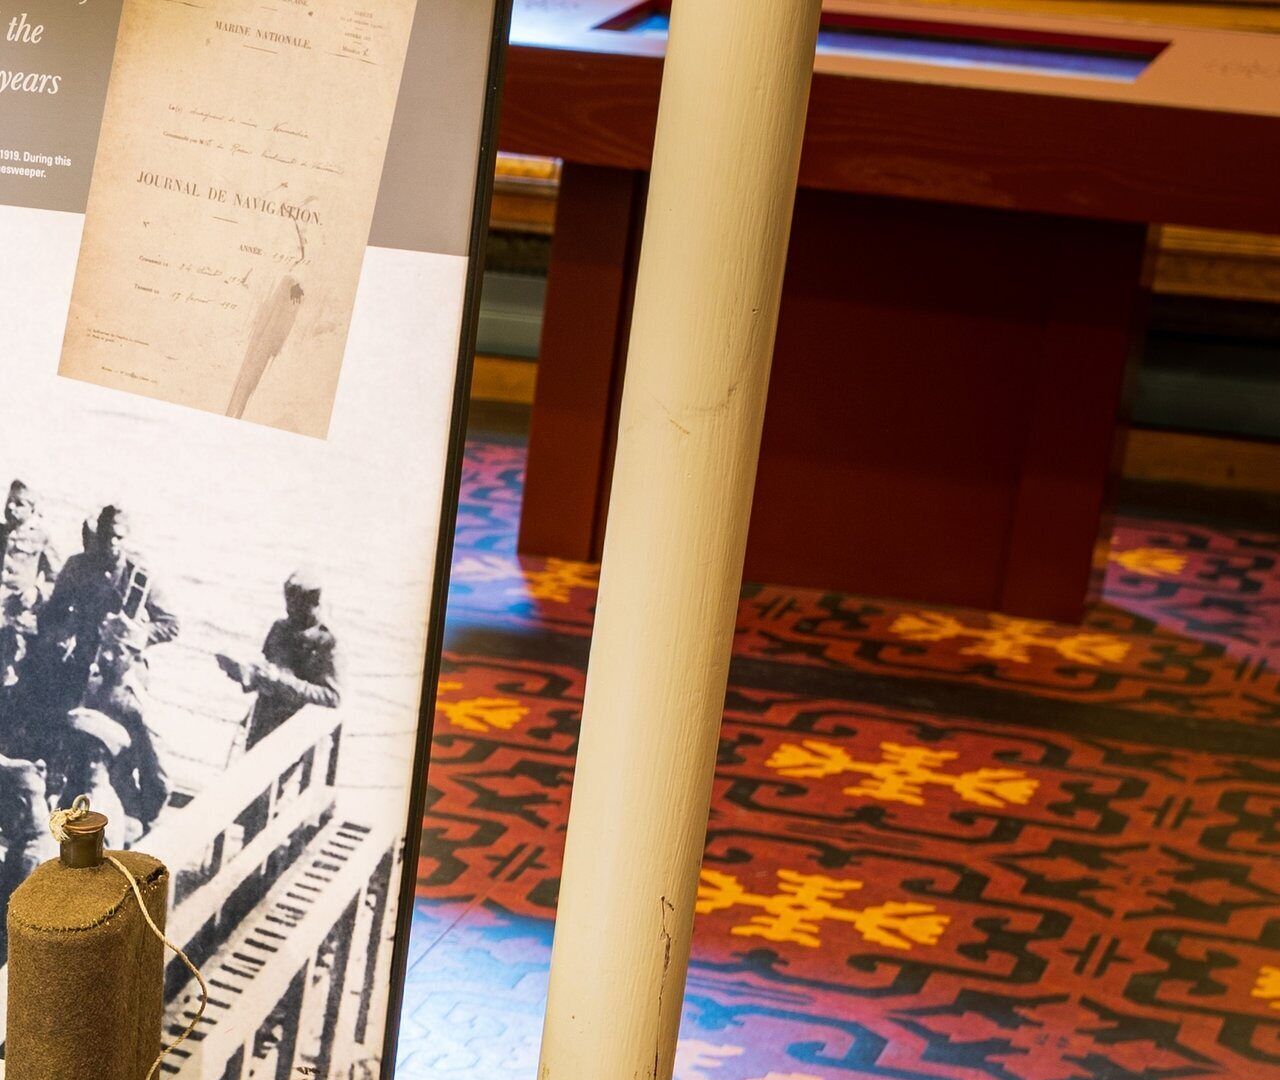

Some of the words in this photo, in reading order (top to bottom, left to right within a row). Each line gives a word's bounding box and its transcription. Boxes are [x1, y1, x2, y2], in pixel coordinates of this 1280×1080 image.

[6, 13, 44, 44] the
[214, 20, 251, 37] MARINE
[256, 29, 312, 50] NATIONALE.
[23, 151, 53, 167] During
[54, 155, 72, 167] this
[136, 171, 200, 198] JOURNAL
[208, 187, 226, 204] DE
